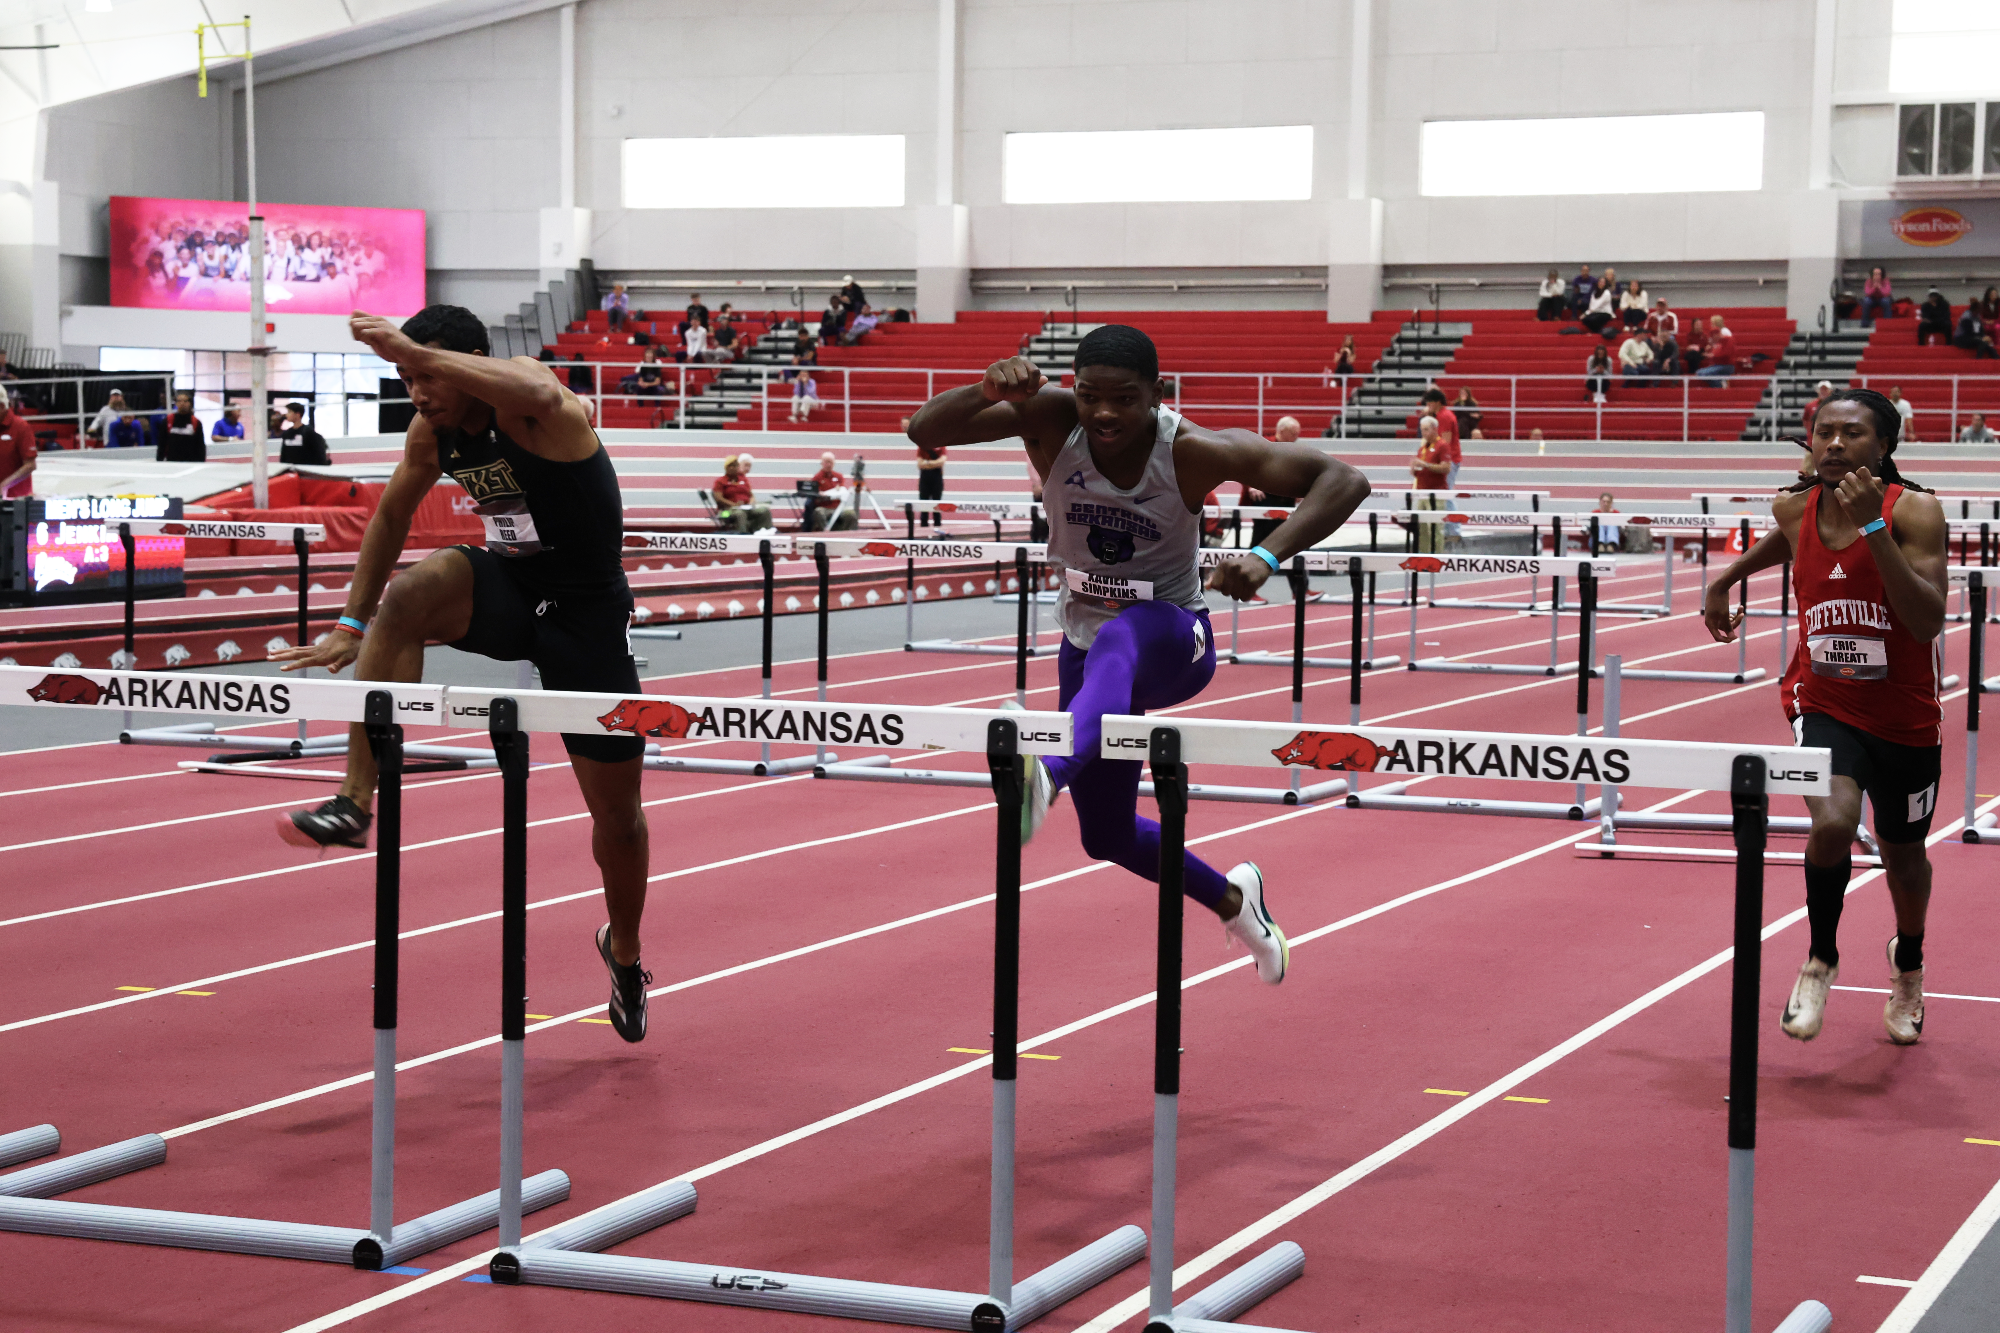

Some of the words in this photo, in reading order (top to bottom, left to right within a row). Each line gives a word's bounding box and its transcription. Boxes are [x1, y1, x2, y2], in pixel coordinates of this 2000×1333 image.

[1889, 219, 1930, 236] Tyson
[1933, 218, 1972, 232] Foods
[454, 459, 522, 501] TXST
[451, 496, 477, 510] UC
[958, 504, 1010, 513] ARKANSAS
[1071, 503, 1157, 530] CENTRAL
[1470, 515, 1529, 524] ARKANSAS
[1653, 516, 1716, 526] ARKANSAS
[187, 523, 266, 538] ARKANSAS
[1066, 513, 1162, 541] ARKANSAS
[649, 536, 728, 551] ARKANSAS
[899, 544, 983, 559] ARKANSAS
[1444, 558, 1540, 574] ARKANSAS
[1081, 581, 1138, 599] SIMPKINS
[1805, 599, 1892, 635] COFFEYVILLE
[1832, 640, 1857, 652] ERIC
[1824, 651, 1868, 664] THREATT
[103, 677, 291, 715] ARKANSAS
[398, 701, 434, 712] UCS
[453, 705, 489, 716] UCS
[696, 707, 905, 746] ARKANSAS
[1020, 731, 1062, 743] UCS
[1107, 737, 1148, 749] UCS
[1386, 739, 1630, 784] ARKANSAS
[1769, 769, 1819, 782] UCS
[1917, 791, 1928, 816] 1
